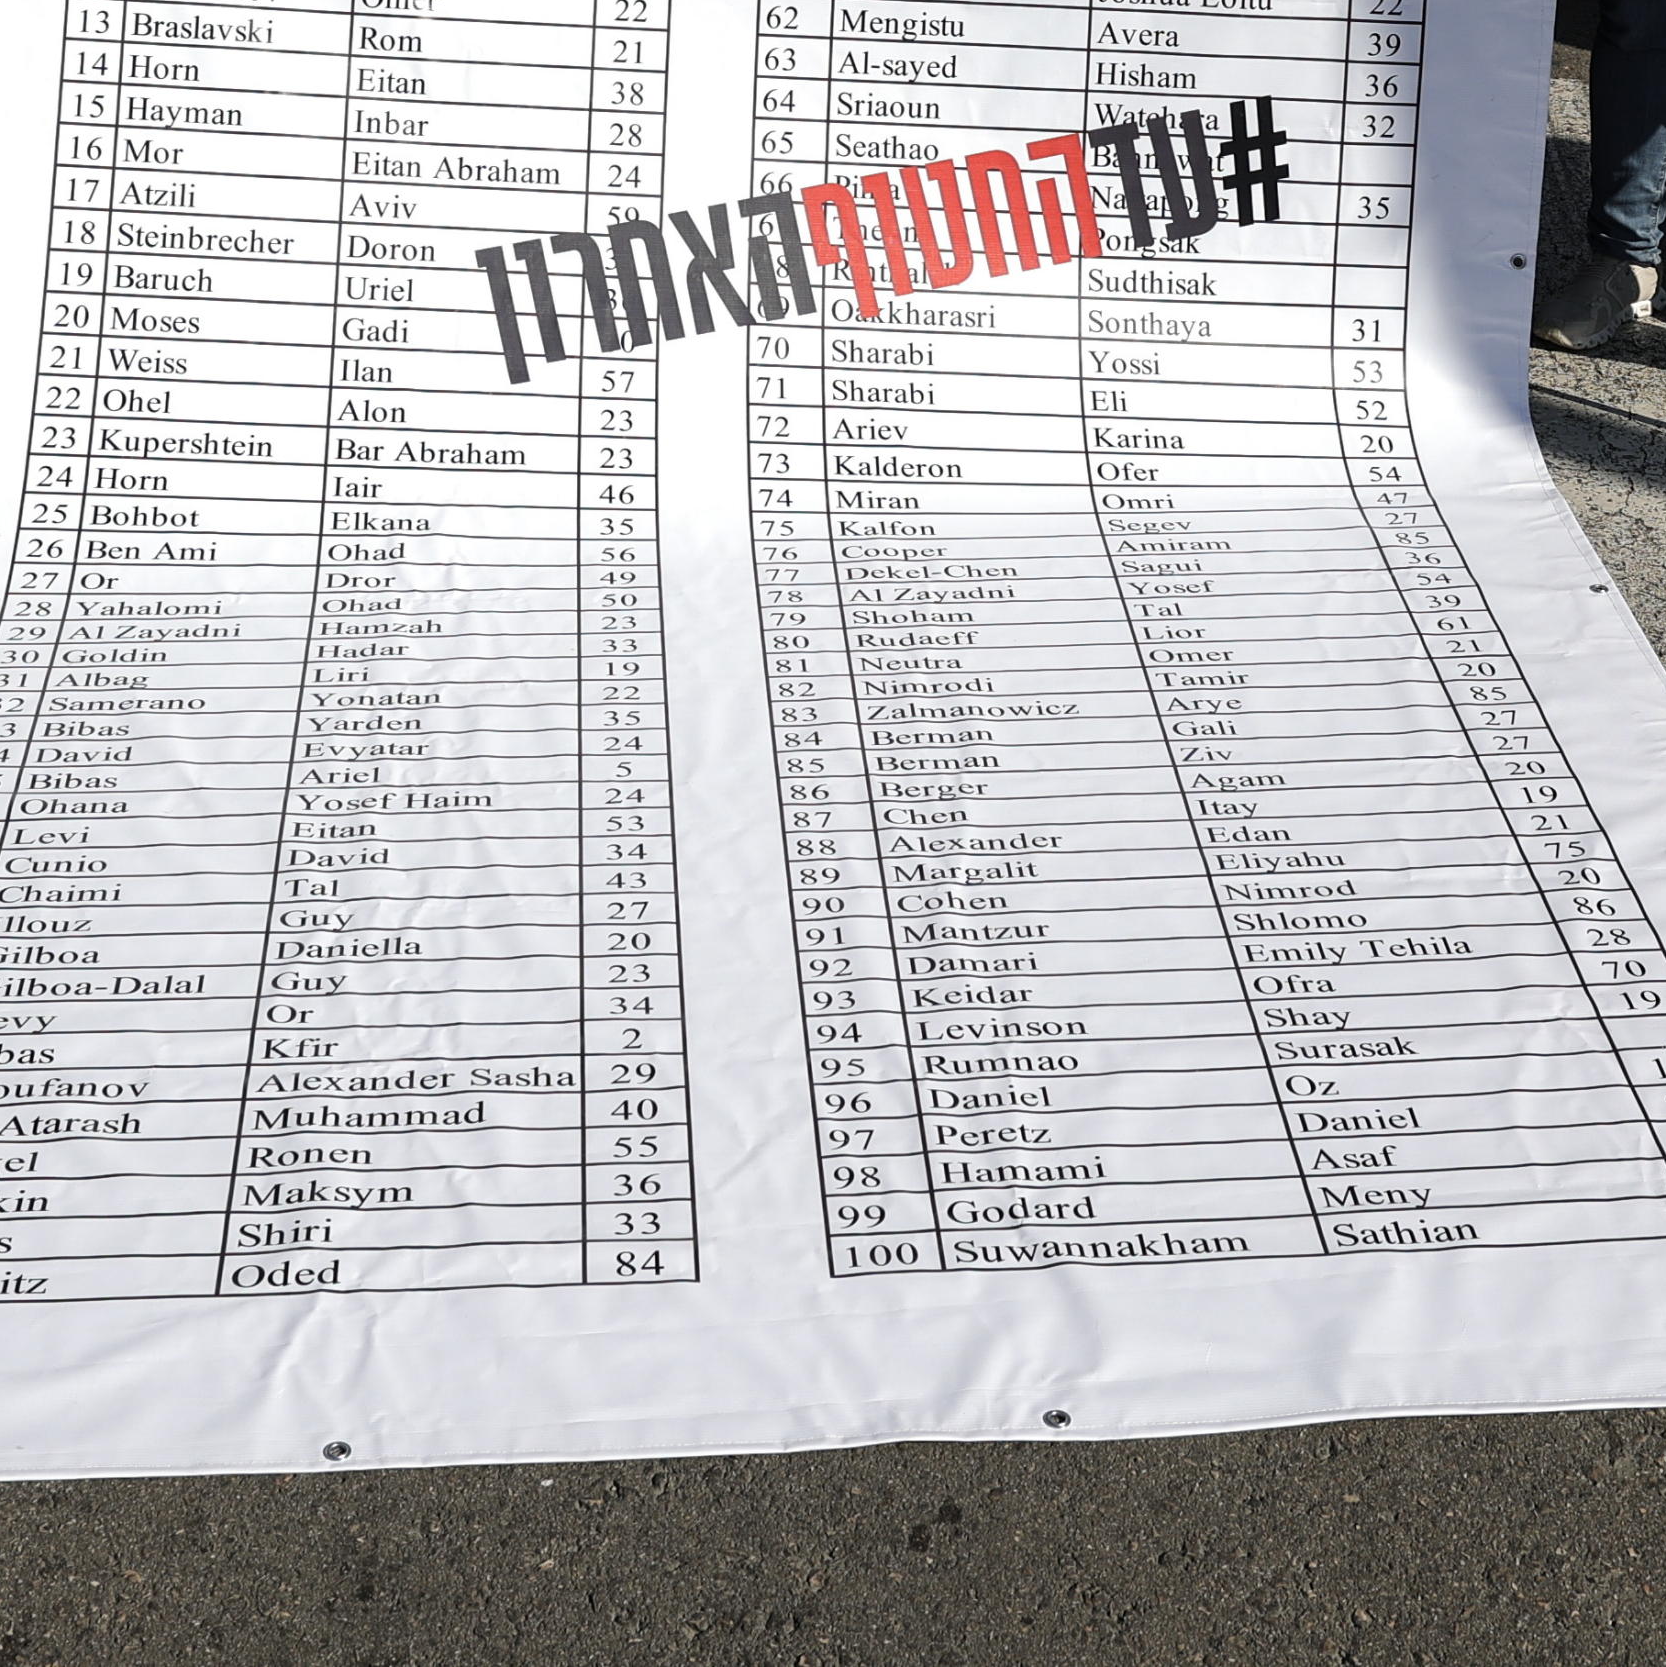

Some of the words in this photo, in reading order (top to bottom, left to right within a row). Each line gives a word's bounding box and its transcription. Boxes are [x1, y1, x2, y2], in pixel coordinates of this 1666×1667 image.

[801, 132, 1103, 320] החטוף
[475, 188, 817, 385] האחרון
[756, 452, 791, 475] 73
[833, 454, 964, 479] Kalderon
[1096, 461, 1160, 482] Ofer
[1368, 465, 1403, 483] 54
[255, 1069, 456, 1093] Alexander
[470, 1065, 577, 1088] Sasha
[610, 1062, 657, 1085] 29
[846, 1242, 919, 1269] 100
[953, 1232, 1252, 1264] Suwannakham
[1332, 1220, 1481, 1248] Sathian
[231, 1258, 341, 1289] Oded
[615, 1249, 666, 1277] 84
